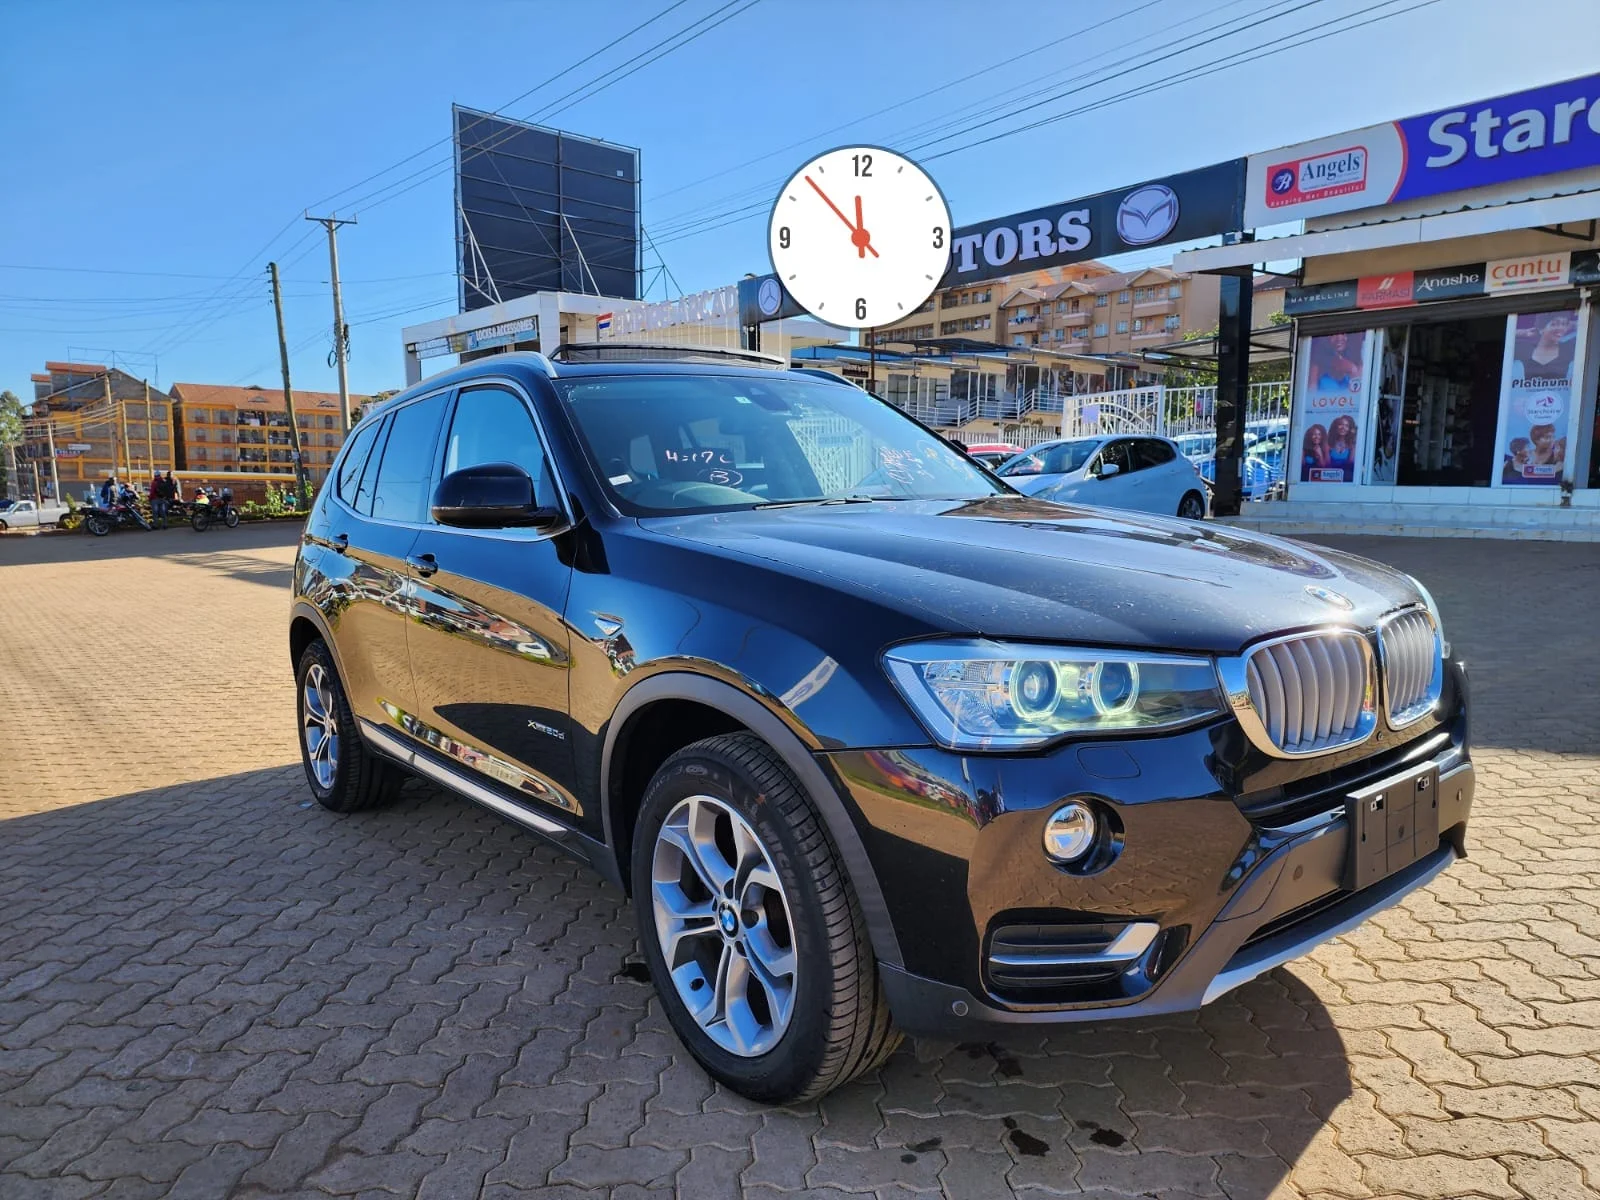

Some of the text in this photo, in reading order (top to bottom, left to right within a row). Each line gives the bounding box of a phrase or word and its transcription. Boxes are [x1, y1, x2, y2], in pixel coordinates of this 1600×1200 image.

[1301, 152, 1361, 181] Angels
[945, 208, 1092, 273] TORS
[1492, 258, 1562, 280] cantu
[1417, 273, 1479, 292] Anashe
[1291, 291, 1350, 304] MAYBELLINE
[1512, 377, 1568, 389] Platinum
